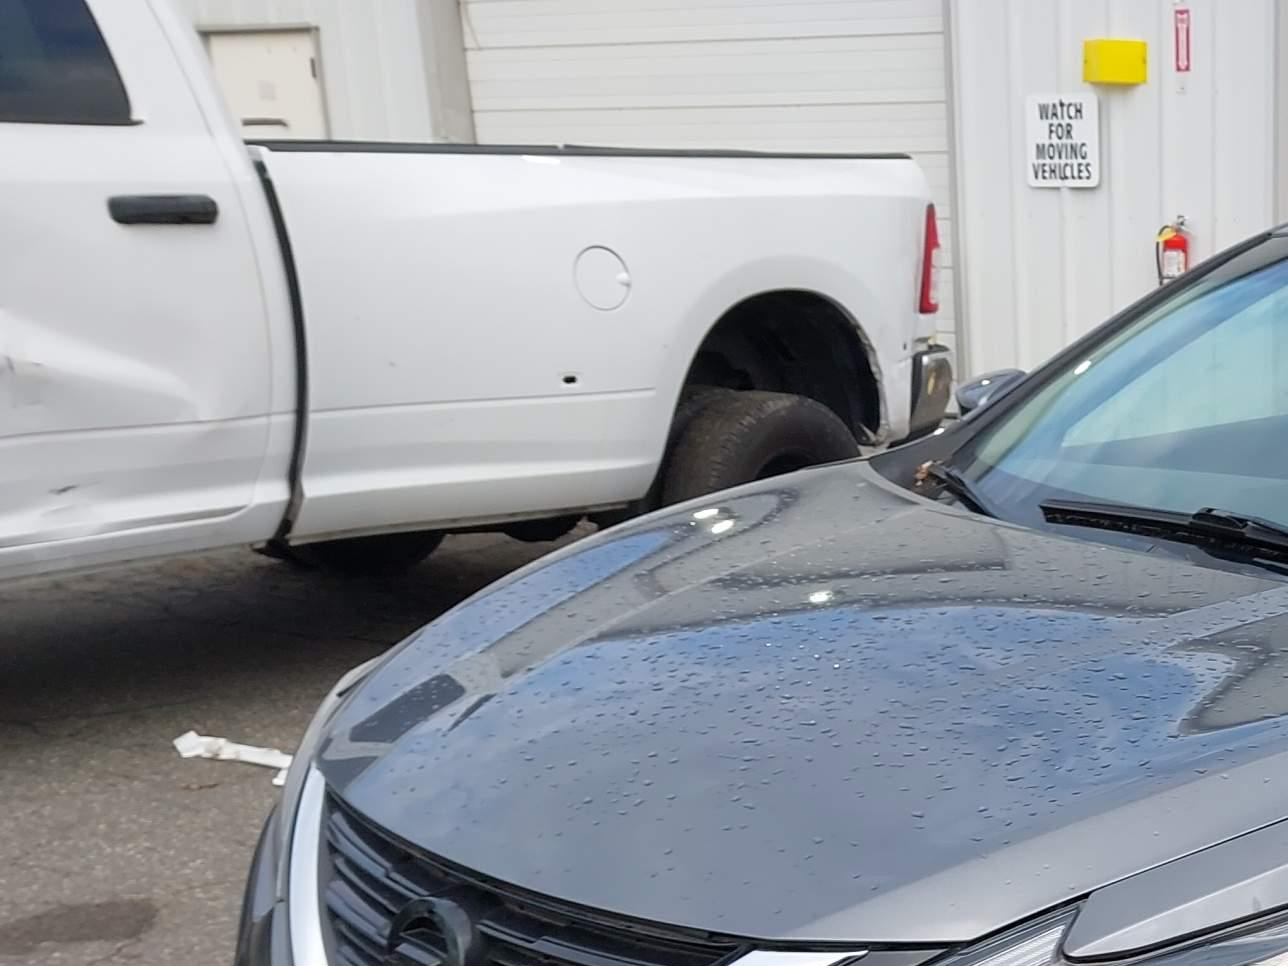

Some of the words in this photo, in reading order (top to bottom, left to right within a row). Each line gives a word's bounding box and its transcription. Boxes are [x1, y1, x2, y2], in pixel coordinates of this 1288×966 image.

[1038, 102, 1083, 120] WATCH
[1048, 122, 1073, 140] FOR
[1035, 142, 1088, 160] MOVING
[1032, 162, 1092, 180] VEHICLES
